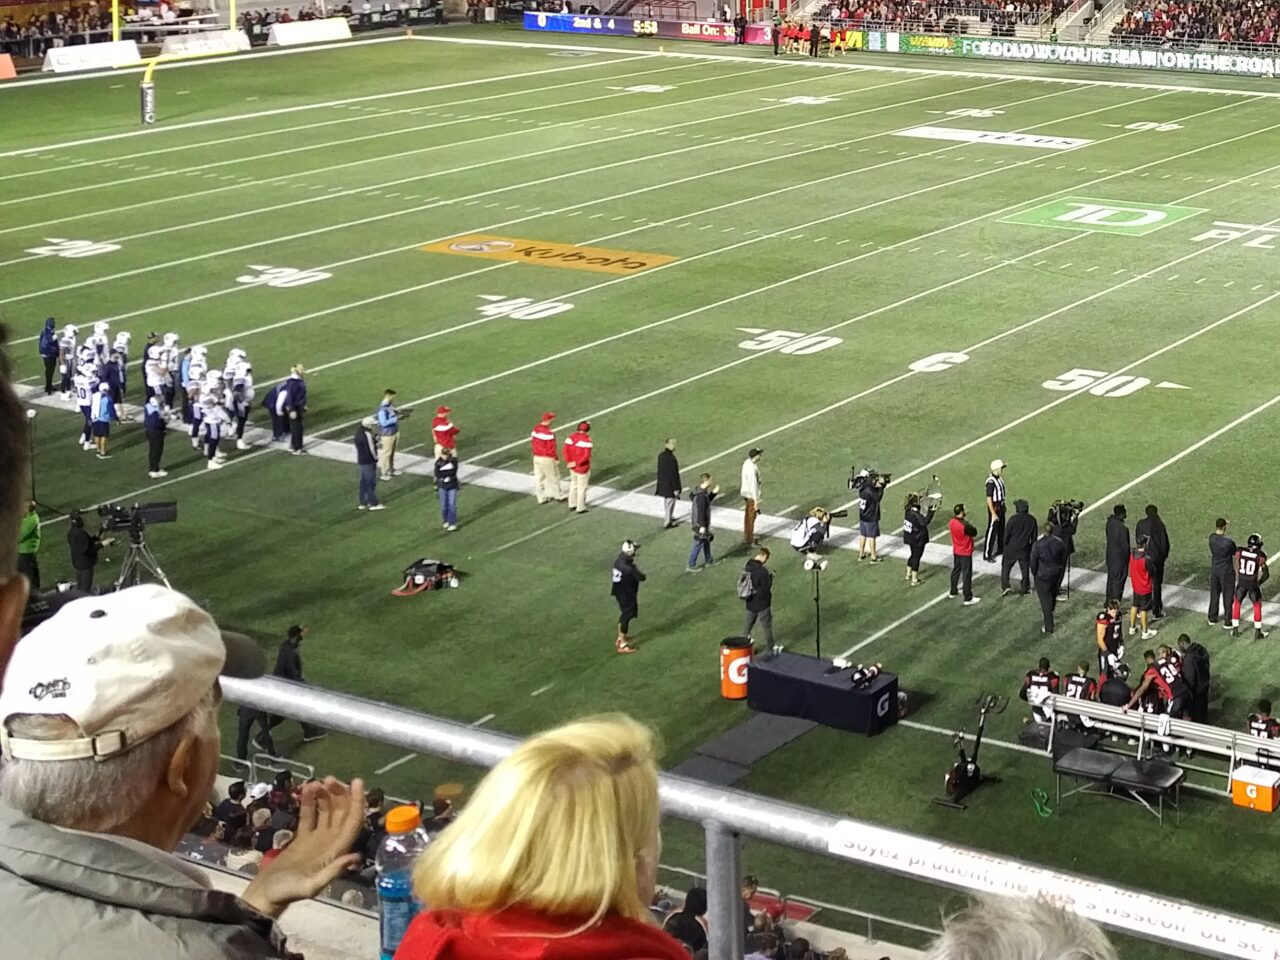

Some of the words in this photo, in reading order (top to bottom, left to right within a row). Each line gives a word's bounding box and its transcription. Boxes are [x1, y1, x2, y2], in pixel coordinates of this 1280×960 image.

[537, 15, 546, 27] 0
[573, 17, 591, 28] 2nd
[608, 19, 615, 30] 4
[682, 23, 699, 35] Ball
[702, 24, 719, 36] On:
[1051, 202, 1167, 228] TD
[514, 246, 648, 270] Kubota
[235, 267, 333, 288] 30
[476, 297, 575, 320] 40
[738, 330, 843, 355] 50
[909, 352, 970, 372] C
[1042, 368, 1151, 397] 50
[1239, 559, 1256, 576] 10
[728, 656, 749, 685] G
[877, 692, 890, 717] G
[1246, 785, 1257, 797] G
[843, 840, 900, 861] Soyez
